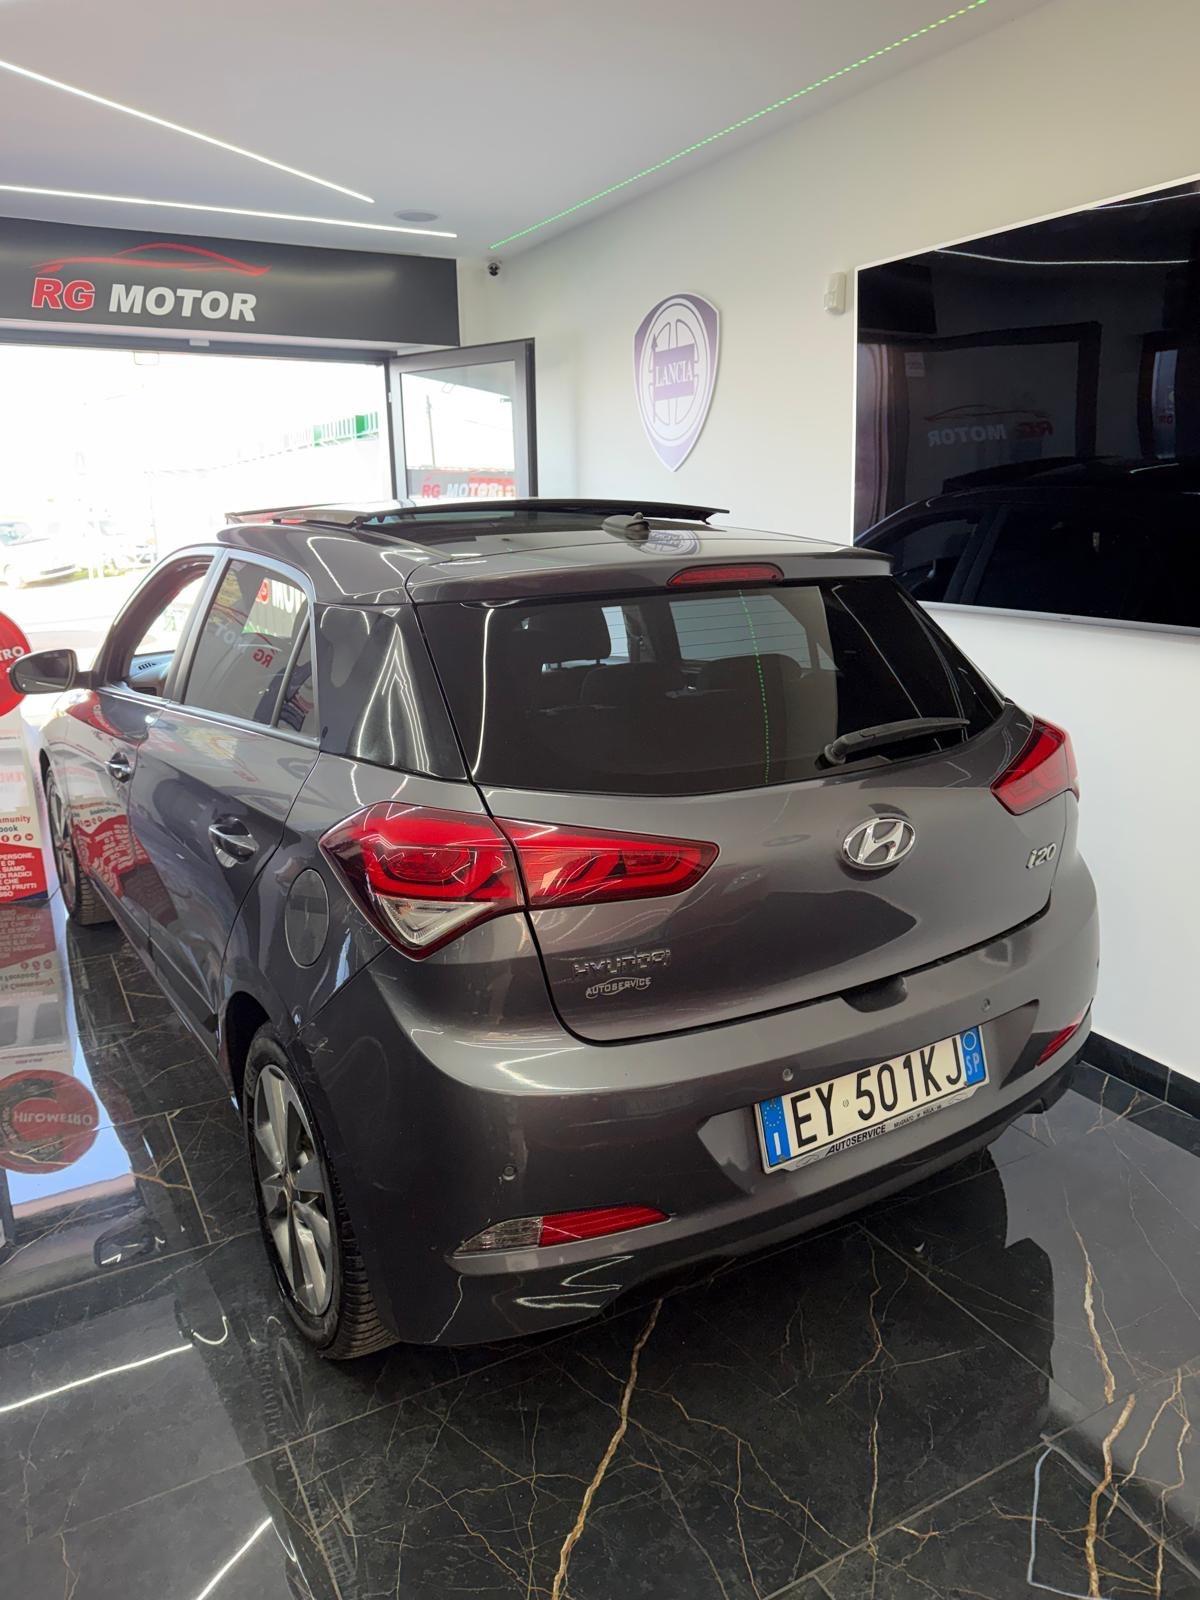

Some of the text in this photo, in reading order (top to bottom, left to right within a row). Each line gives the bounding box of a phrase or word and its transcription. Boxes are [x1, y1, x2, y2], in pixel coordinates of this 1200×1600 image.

[31, 277, 257, 322] RG MOTOR
[655, 359, 694, 388] LANCIA
[422, 483, 441, 498] RG
[1025, 842, 1057, 869] i20
[586, 977, 652, 996] AUTOSERVICE
[965, 1054, 980, 1076] SP
[790, 1083, 834, 1148] EY
[825, 1124, 886, 1156] AUTOSERVICE
